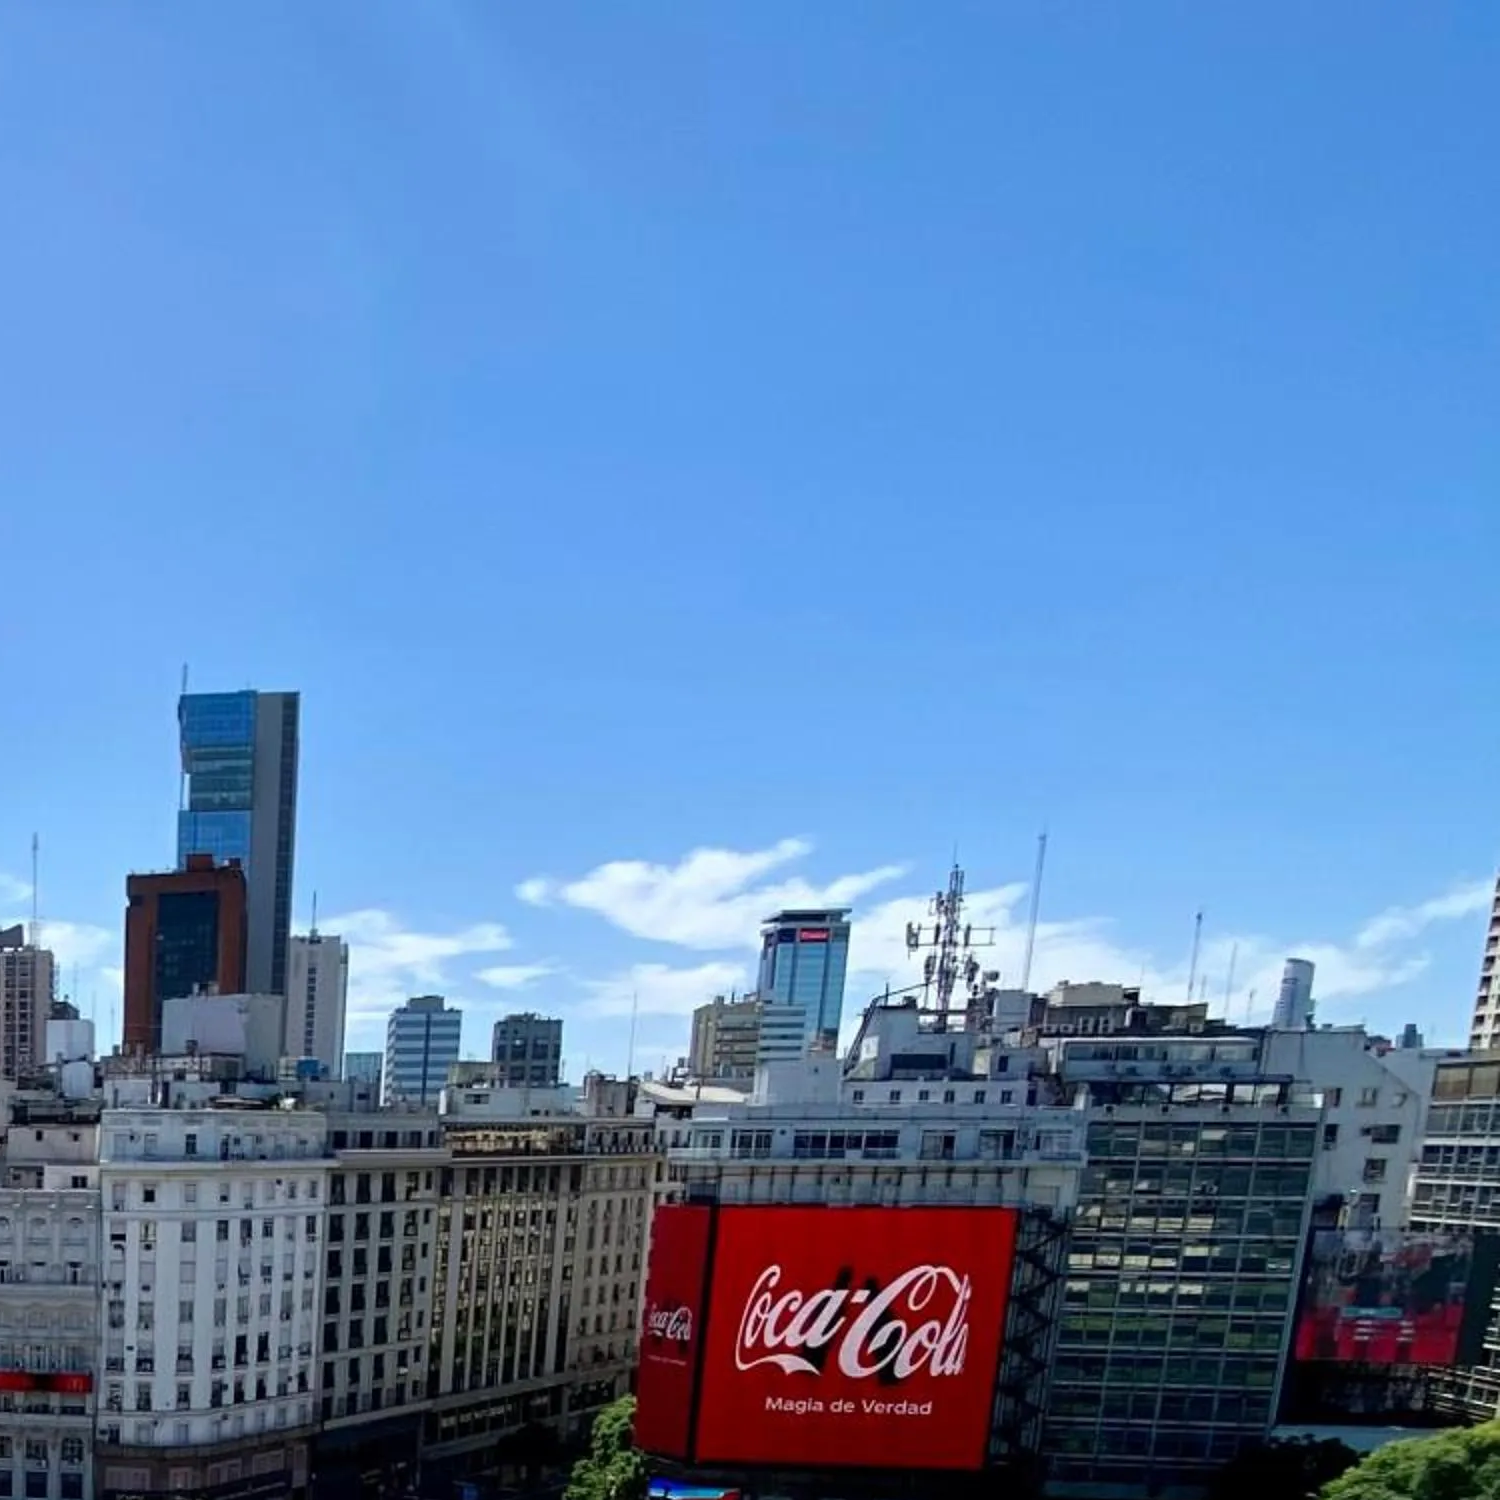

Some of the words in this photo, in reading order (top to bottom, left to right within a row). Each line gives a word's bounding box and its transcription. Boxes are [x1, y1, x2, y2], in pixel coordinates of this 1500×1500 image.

[735, 1264, 972, 1379] Coca-Cola
[764, 1397, 824, 1415] Magia
[830, 1398, 855, 1413] de
[861, 1399, 933, 1415] Verdad
